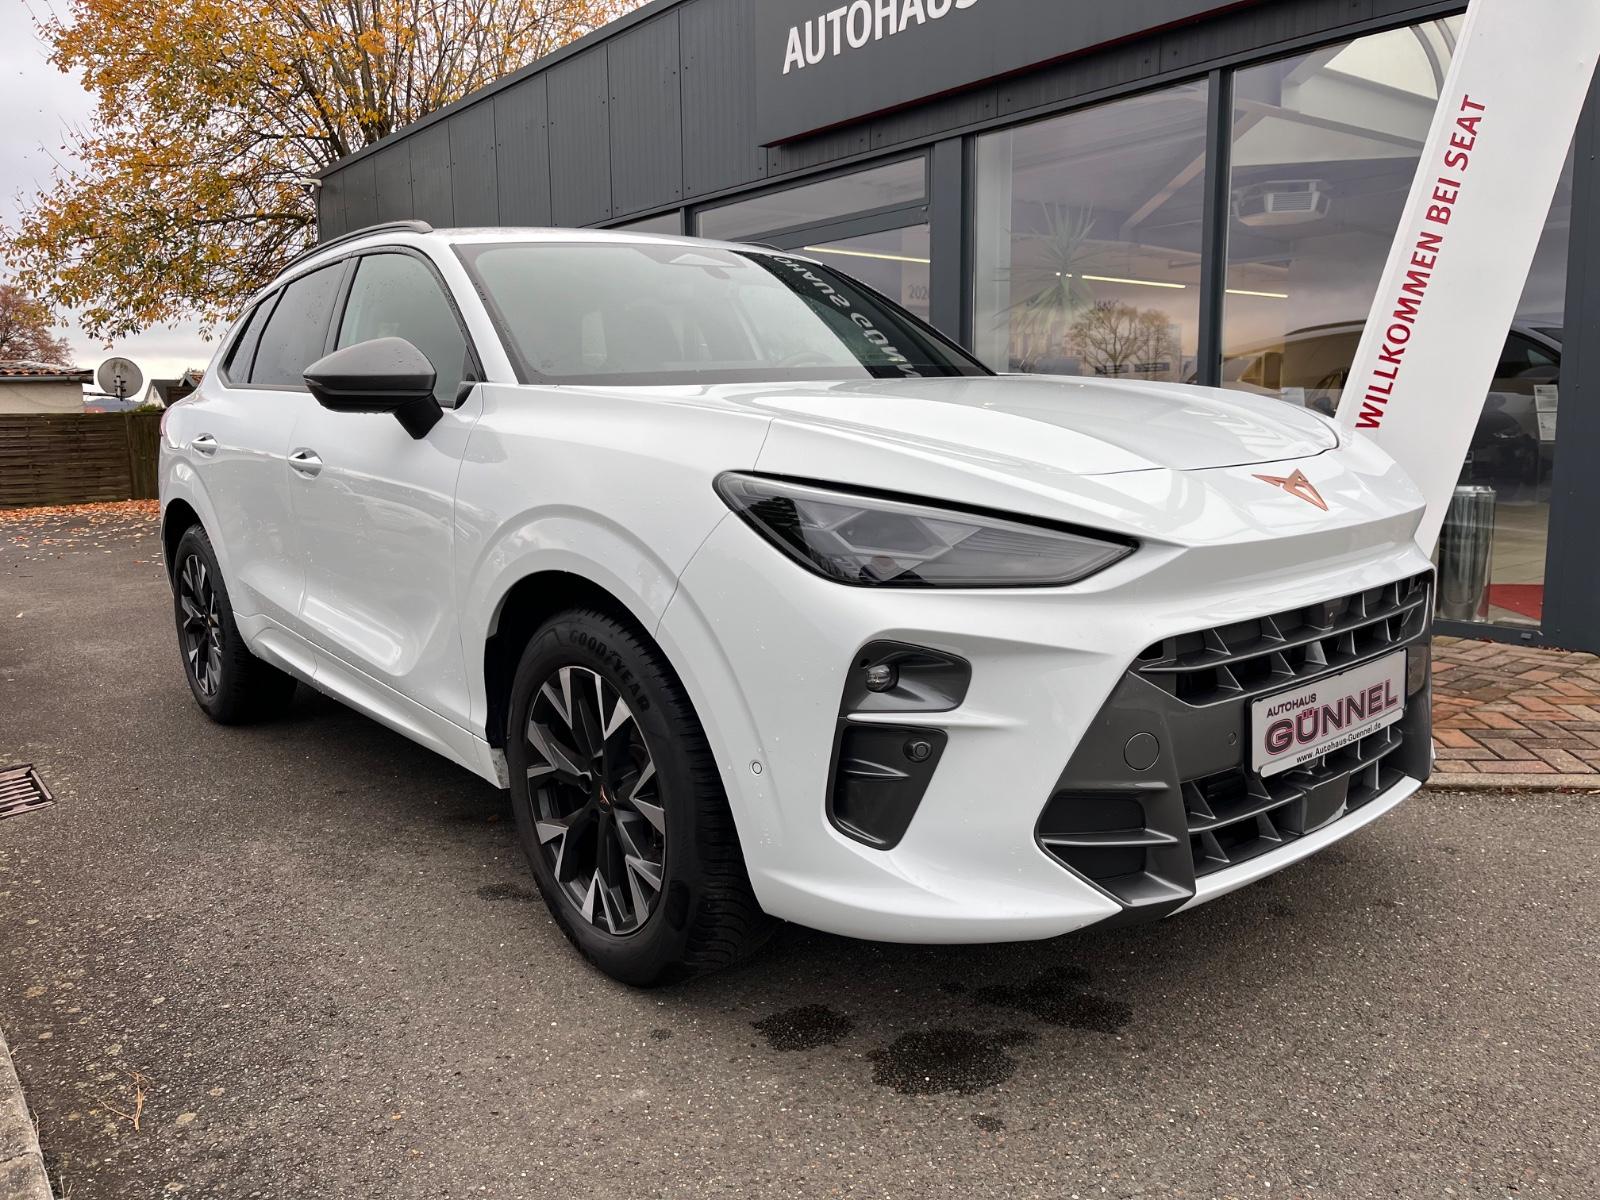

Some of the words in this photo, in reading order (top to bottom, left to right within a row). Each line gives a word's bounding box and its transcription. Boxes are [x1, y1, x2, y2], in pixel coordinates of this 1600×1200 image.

[783, 0, 978, 75] AUTOHA
[1355, 231, 1443, 429] WILLKOMMEN
[1425, 177, 1461, 225] BEI
[1444, 94, 1486, 172] SEAT
[569, 630, 650, 712] GOODYEAR
[1266, 693, 1317, 718] AUTOHAUS
[1265, 679, 1398, 755] GÜNNEL
[1296, 721, 1381, 763] www.Autohaus-Guennel.de
